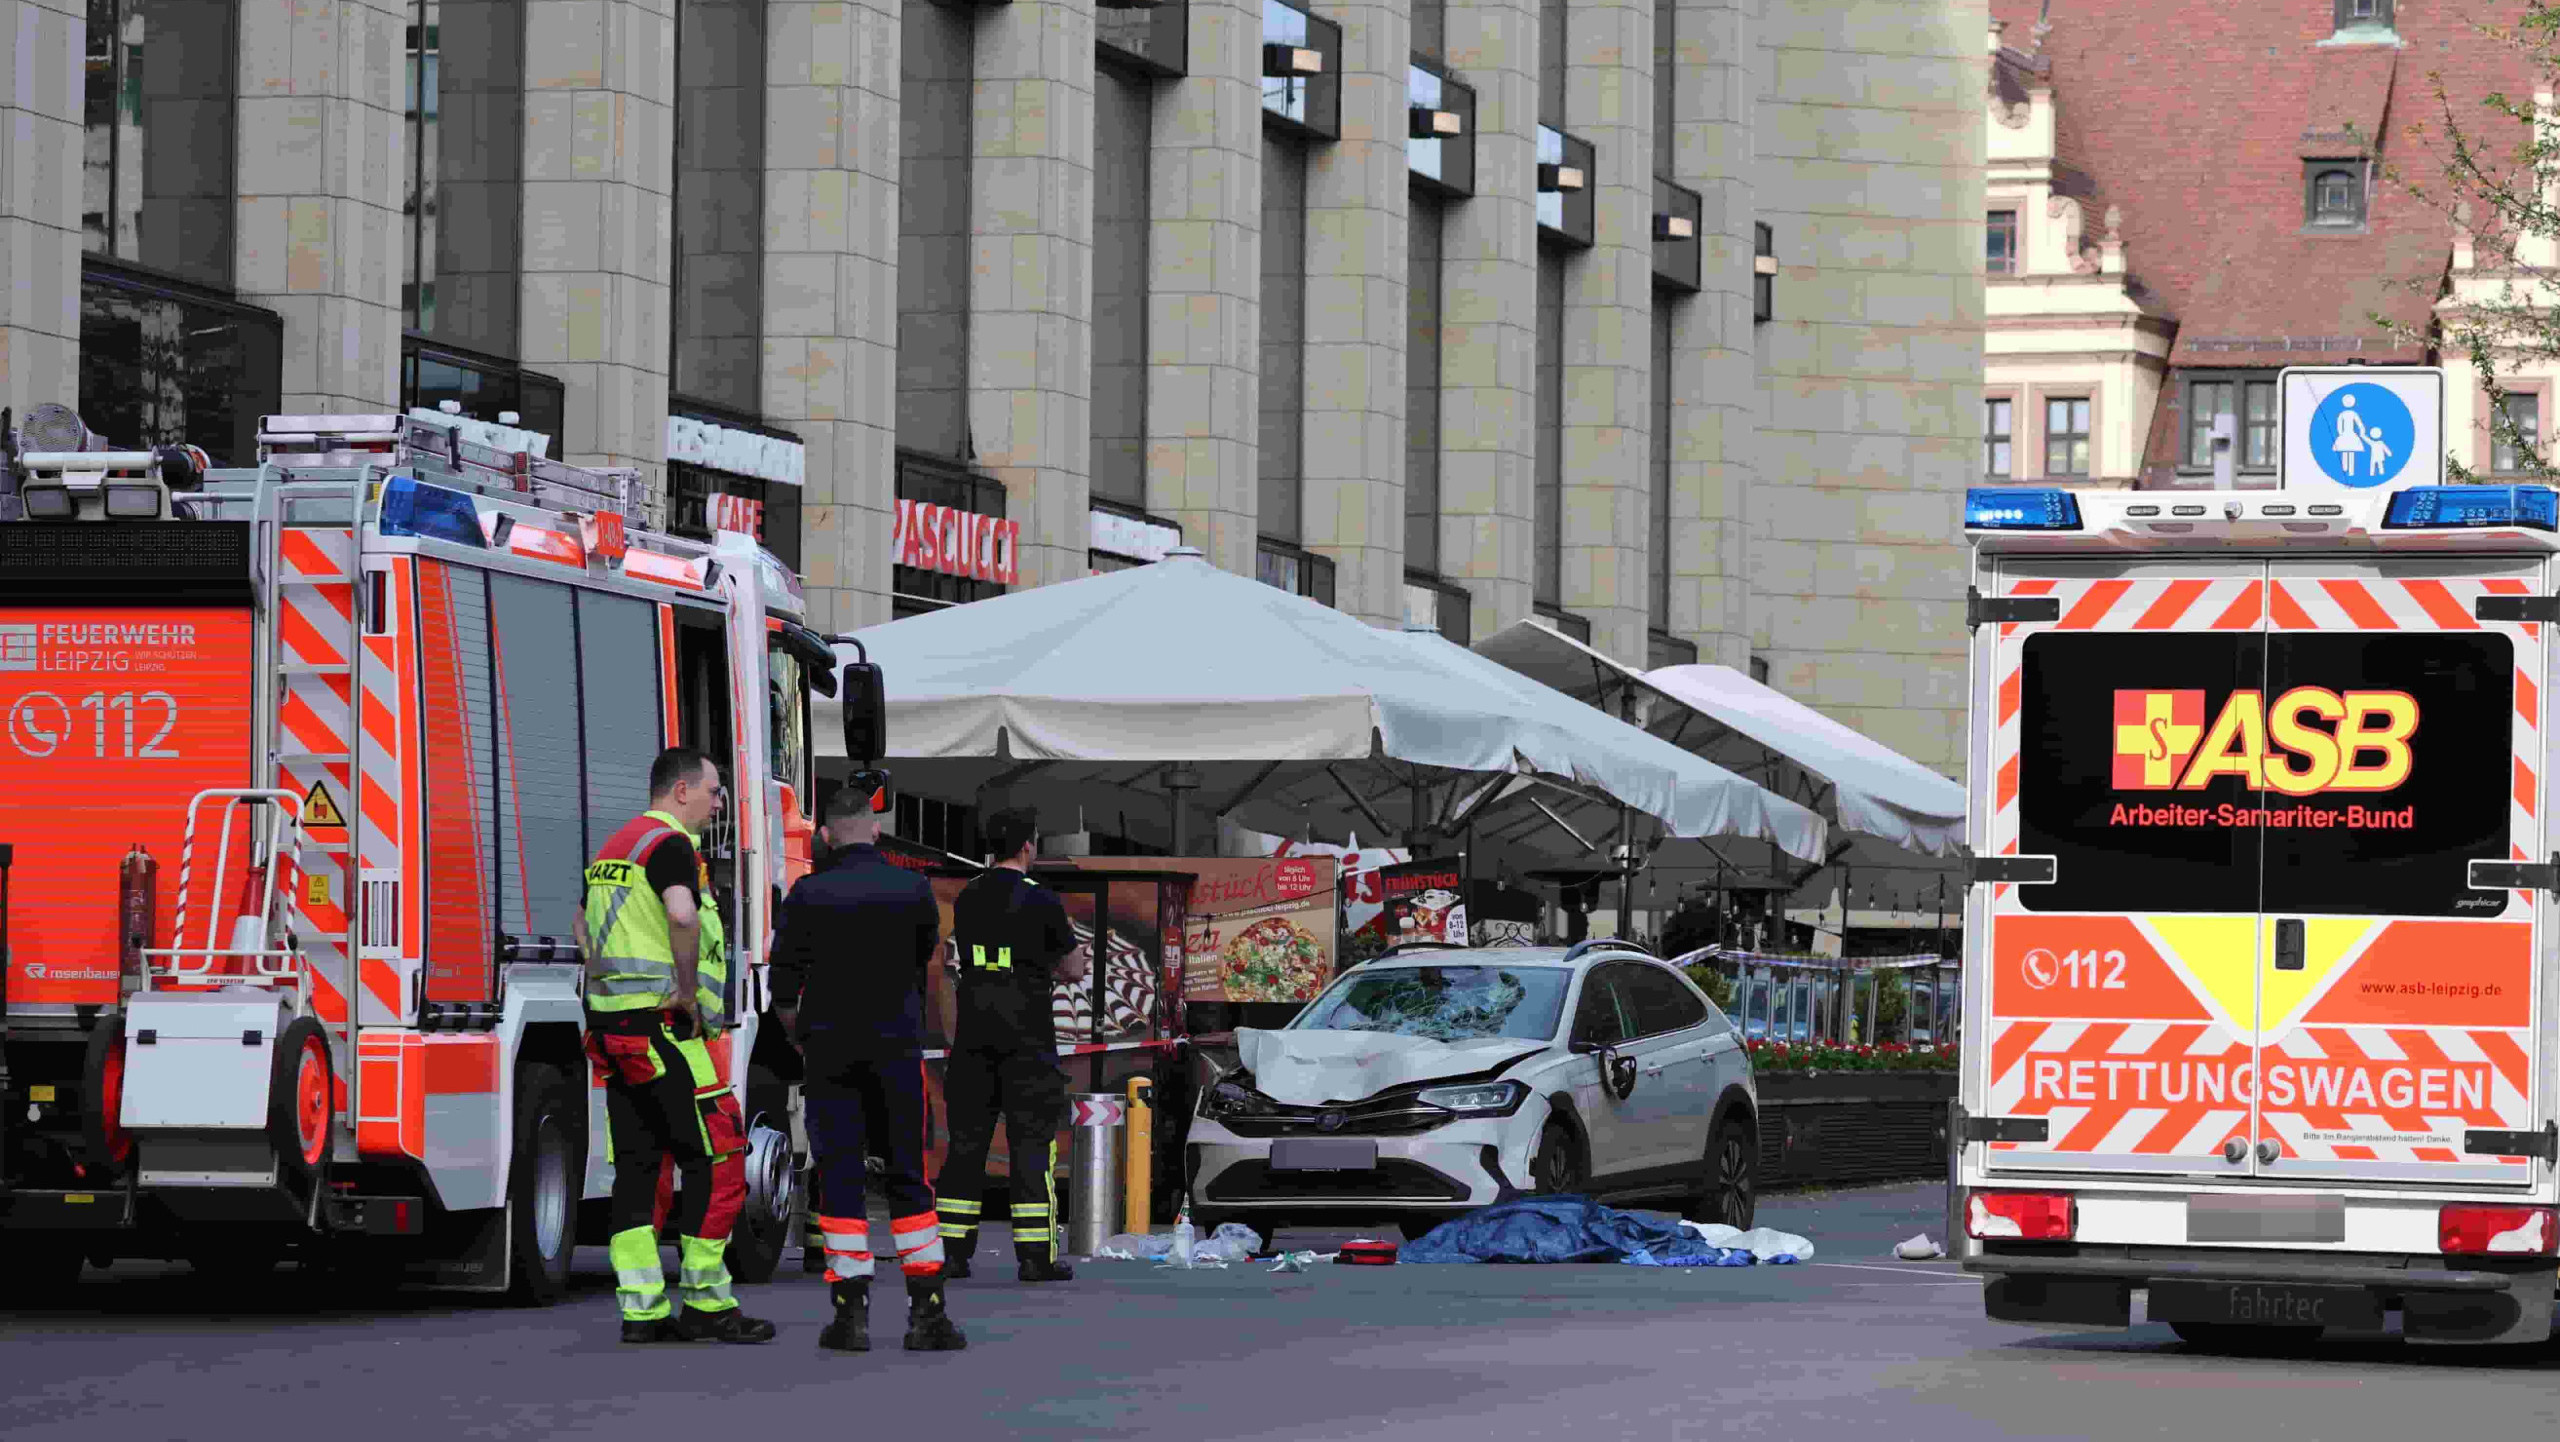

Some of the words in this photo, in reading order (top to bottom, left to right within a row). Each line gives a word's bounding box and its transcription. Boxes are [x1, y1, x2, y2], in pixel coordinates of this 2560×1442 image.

[42, 624, 195, 645] FEUERWEHR
[43, 650, 129, 671] LEIPZIG
[81, 691, 180, 758] 112
[2176, 686, 2420, 796] ASB
[2109, 803, 2414, 830] Arbeiter-Samariter-Bund
[1299, 874, 1311, 882] Uhr
[1299, 883, 1312, 892] Uhr
[1386, 870, 1459, 891] FRÜHSTÜCK
[1453, 929, 1465, 939] Uhr
[1188, 953, 1218, 965] Italien
[2062, 949, 2126, 990] 112
[2361, 982, 2502, 999] www.asb-leipzig.de
[2033, 1060, 2484, 1110] RETTUNGSWAGEN
[2303, 1132, 2320, 1140] Bitte
[2230, 1287, 2324, 1320] fahrtec
